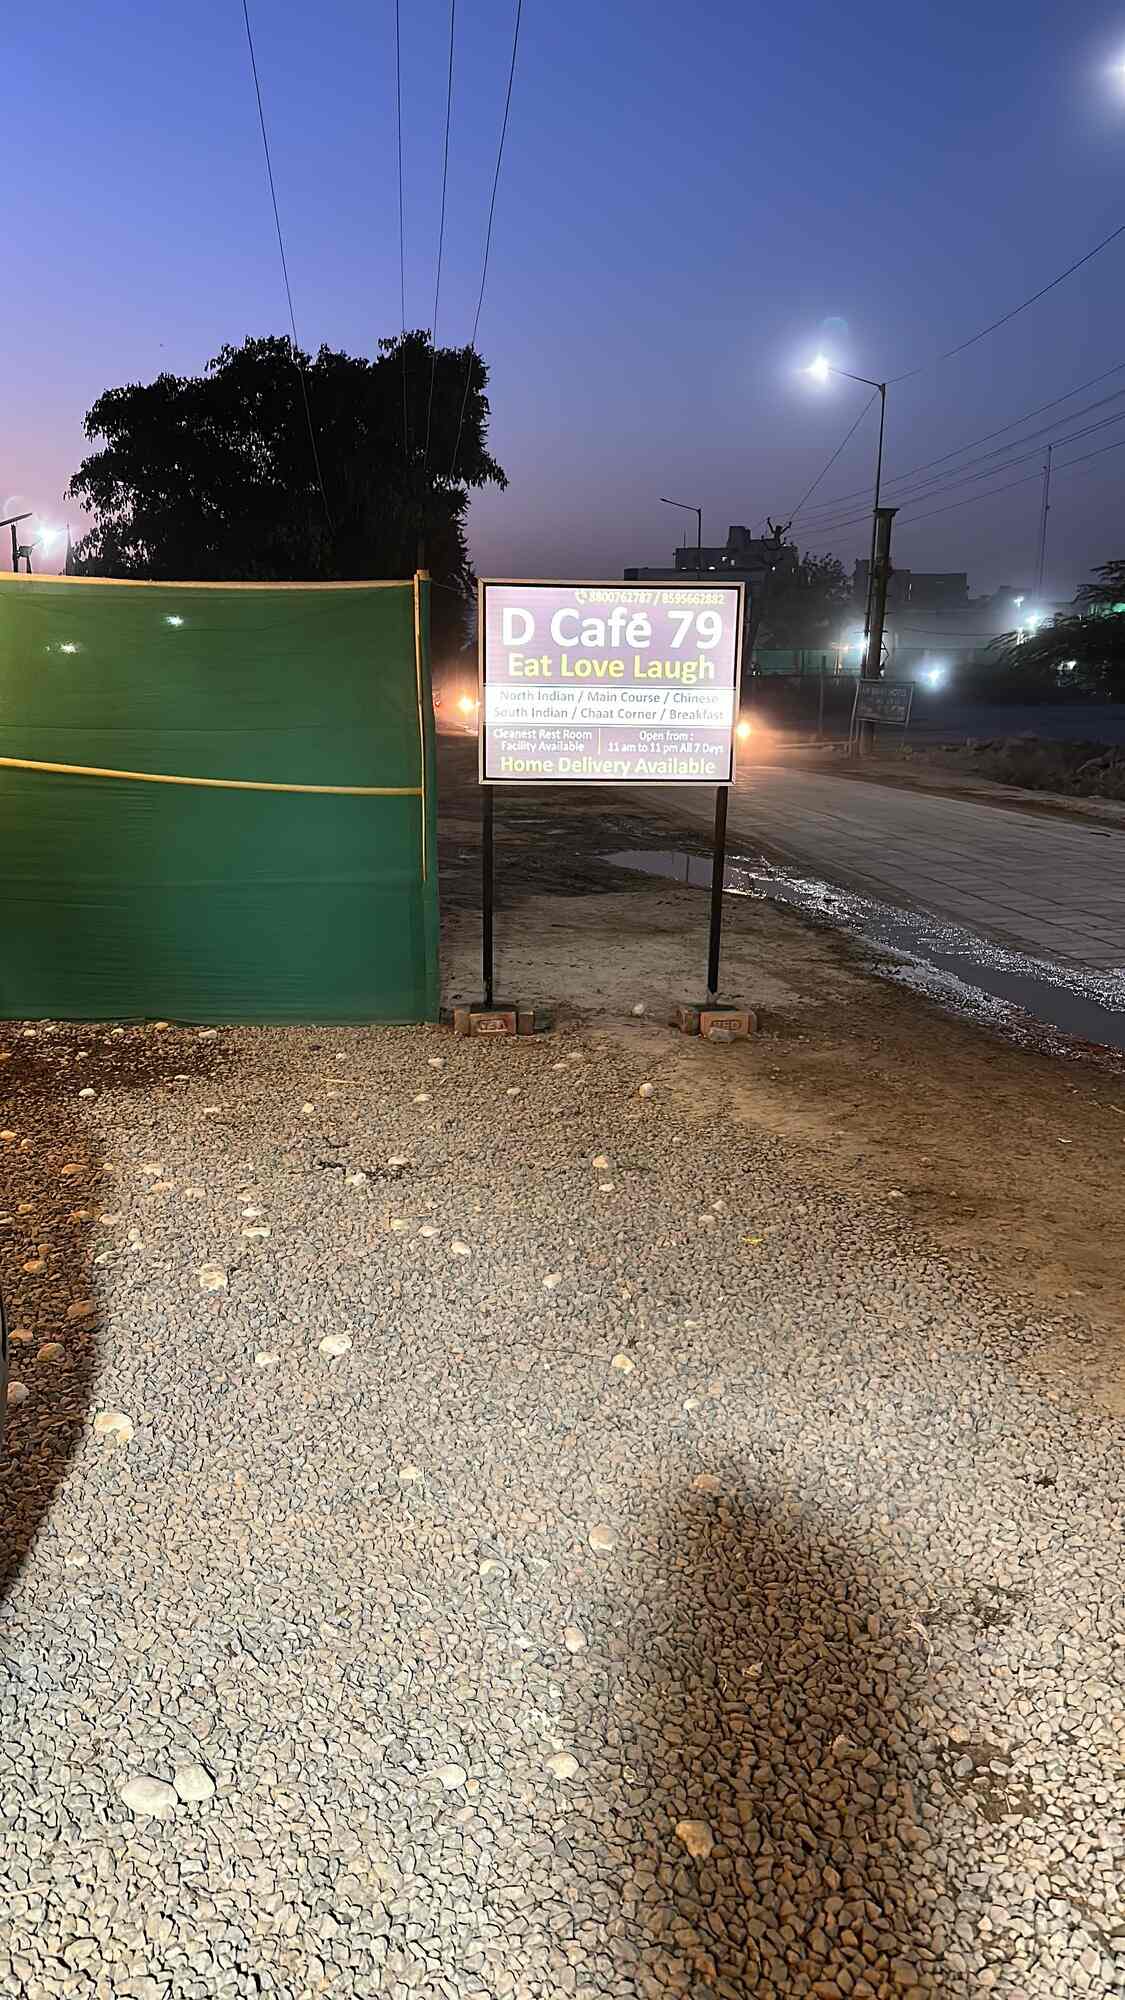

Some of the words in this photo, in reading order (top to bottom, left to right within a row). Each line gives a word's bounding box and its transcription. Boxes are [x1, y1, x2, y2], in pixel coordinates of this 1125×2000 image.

[502, 607, 535, 646] D
[550, 606, 653, 648] Café
[667, 610, 723, 650] 79
[508, 653, 552, 677] Eat
[560, 654, 624, 678] Love
[634, 655, 715, 684] Laugh
[500, 690, 534, 701] North
[538, 690, 575, 702] Indian
[578, 691, 584, 703] /
[587, 691, 617, 702] Main
[621, 692, 661, 703] Course
[664, 692, 670, 705] /
[673, 693, 719, 704] Chinese
[495, 706, 528, 717] South
[532, 707, 568, 718] Indian
[572, 707, 577, 720] /
[581, 707, 614, 719] Chaat
[618, 708, 657, 720] Corner
[660, 708, 666, 721] /
[670, 709, 724, 721] Breakfast
[494, 728, 536, 739] Cleanest
[539, 729, 561, 739] Rest
[563, 729, 592, 740] Room
[640, 730, 665, 742] Open
[502, 741, 537, 752] Facility
[538, 741, 585, 752] Available
[608, 741, 619, 752] 11
[621, 743, 636, 752] am
[638, 742, 648, 753] to
[649, 742, 661, 753] 11
[663, 744, 678, 755] pm
[679, 743, 692, 753] All
[695, 743, 701, 753] 7
[702, 743, 724, 756] Days
[501, 757, 553, 772] Home
[558, 757, 630, 776] Delivery
[635, 758, 716, 774] Available
